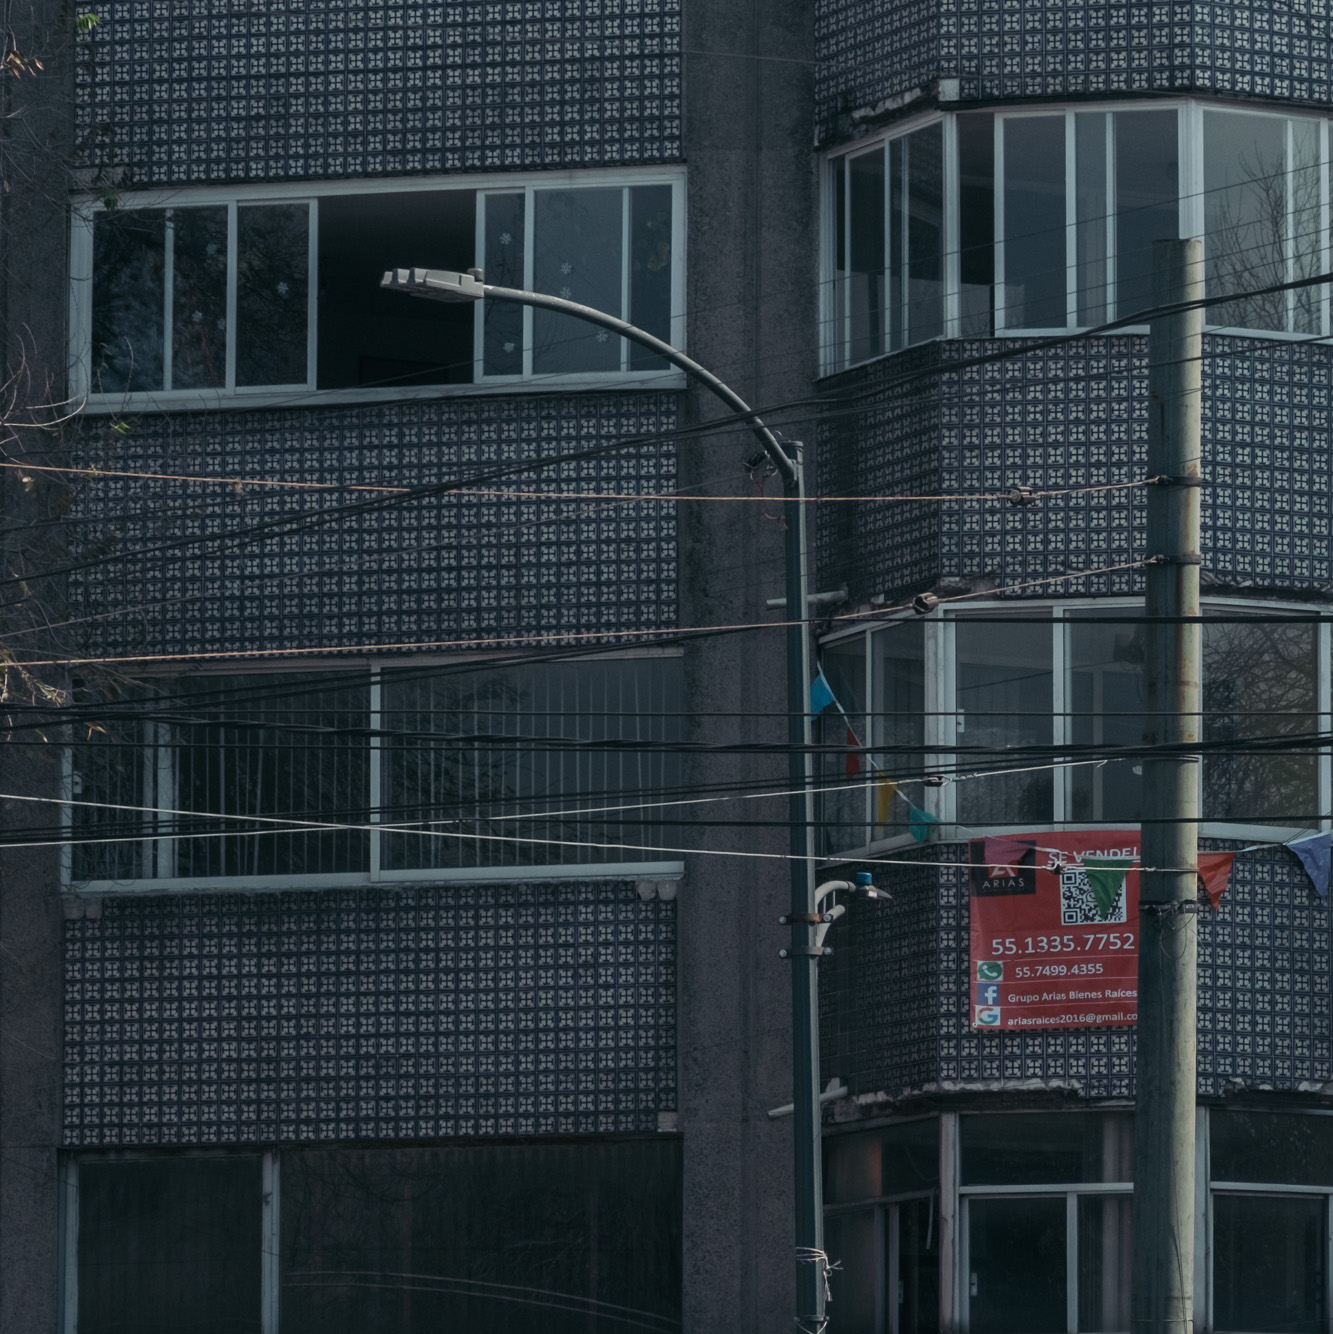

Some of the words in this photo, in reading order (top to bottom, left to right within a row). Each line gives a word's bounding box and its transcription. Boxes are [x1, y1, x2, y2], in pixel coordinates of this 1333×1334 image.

[982, 877, 1025, 889] ARIAS
[991, 933, 1135, 955] 55.1335.7752
[1015, 964, 1104, 978] 55.7499.4355
[1008, 993, 1039, 1004] Grupo
[1041, 991, 1066, 1001] Arias
[1069, 989, 1102, 1000] Bienes
[1105, 988, 1138, 998] Raíces
